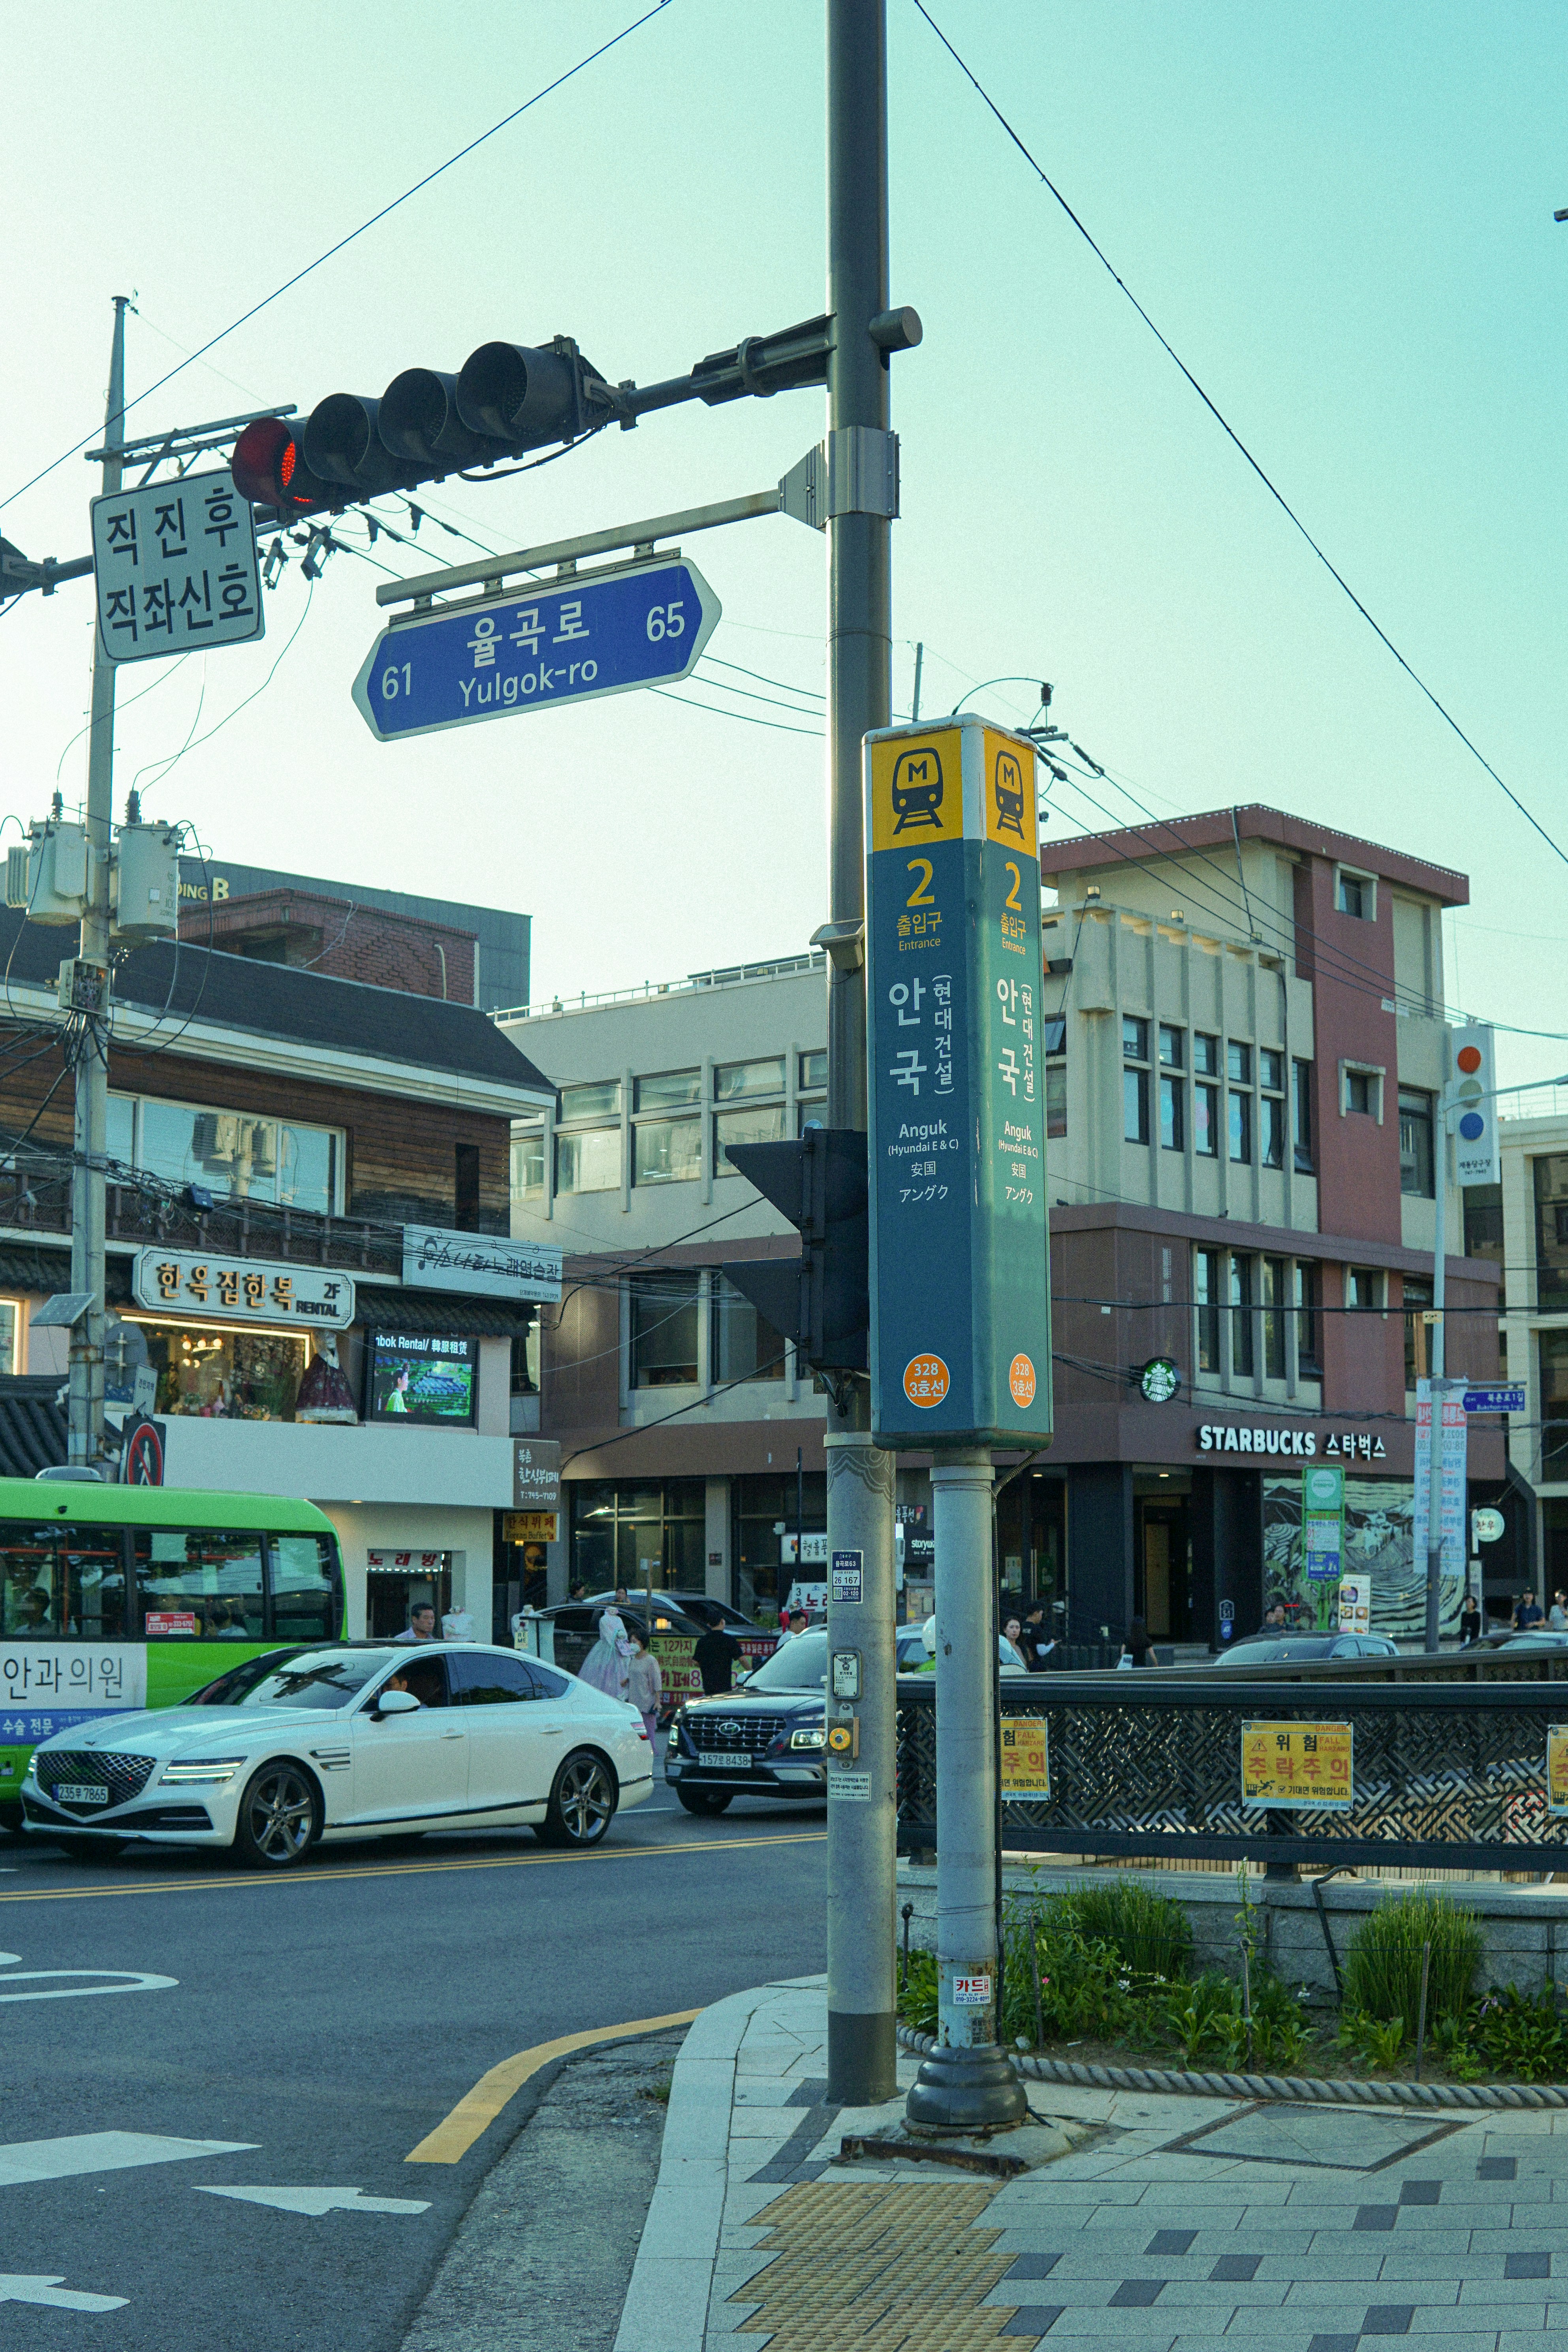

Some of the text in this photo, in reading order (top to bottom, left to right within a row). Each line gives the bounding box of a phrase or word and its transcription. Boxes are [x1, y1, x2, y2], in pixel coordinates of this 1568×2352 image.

[106, 487, 240, 567] 직진후
[106, 564, 254, 641] 직좌신호
[646, 601, 685, 642] 65
[466, 601, 590, 669] 율곡로
[382, 662, 412, 699] 61
[459, 658, 598, 708] Yulgok-ro
[908, 760, 927, 782] M
[1004, 763, 1014, 786] M
[212, 877, 229, 901] B
[907, 859, 934, 907] 2
[1006, 862, 1022, 911] 2
[897, 912, 942, 936] 출입구
[1000, 912, 1026, 940] 출입구
[899, 937, 941, 951] Entrance
[1002, 938, 1026, 955] Entrance
[889, 978, 927, 1095] 안국
[933, 975, 954, 1094] (현대건설)
[997, 979, 1020, 1096] 안국
[1021, 983, 1035, 1102] (현대건설)
[899, 1119, 947, 1139] Anguk
[1005, 1121, 1032, 1141] Anguk
[888, 1139, 959, 1156] (Hyundai E & C)
[998, 1139, 1038, 1158] (Hyundai E & C)
[911, 1161, 936, 1177] 安国
[1011, 1162, 1026, 1179] 安国
[899, 1184, 948, 1203] アングク
[1005, 1186, 1033, 1204] アングク
[157, 1262, 295, 1310] 한옥집한복
[323, 1282, 340, 1299] 2F
[295, 1301, 340, 1317] RENTAL
[398, 1337, 429, 1351] Rental/
[914, 1363, 938, 1376] 328
[1015, 1362, 1029, 1376] 328
[909, 1379, 944, 1397] 3호선
[1013, 1380, 1033, 1398] 3호선
[1200, 1425, 1387, 1461] STARBUCKS 스타벅스
[518, 1449, 531, 1464] 북촌
[519, 1467, 559, 1484] 한식뷔페
[507, 1515, 554, 1529] 한식뷔페
[368, 1553, 437, 1566] 노래방
[648, 1639, 692, 1653] 는 12가지
[4, 1657, 122, 1700] 안과의원
[3, 1718, 25, 1736] 수술
[30, 1718, 53, 1735] 전문
[1276, 1734, 1317, 1752] 위험
[1004, 1752, 1045, 1773] 주의
[1248, 1757, 1348, 1781] 추락주의
[84, 1788, 106, 1801] 7865
[1288, 1786, 1349, 1795] 기대면 위험합니다.
[956, 1980, 983, 1992] 카드
